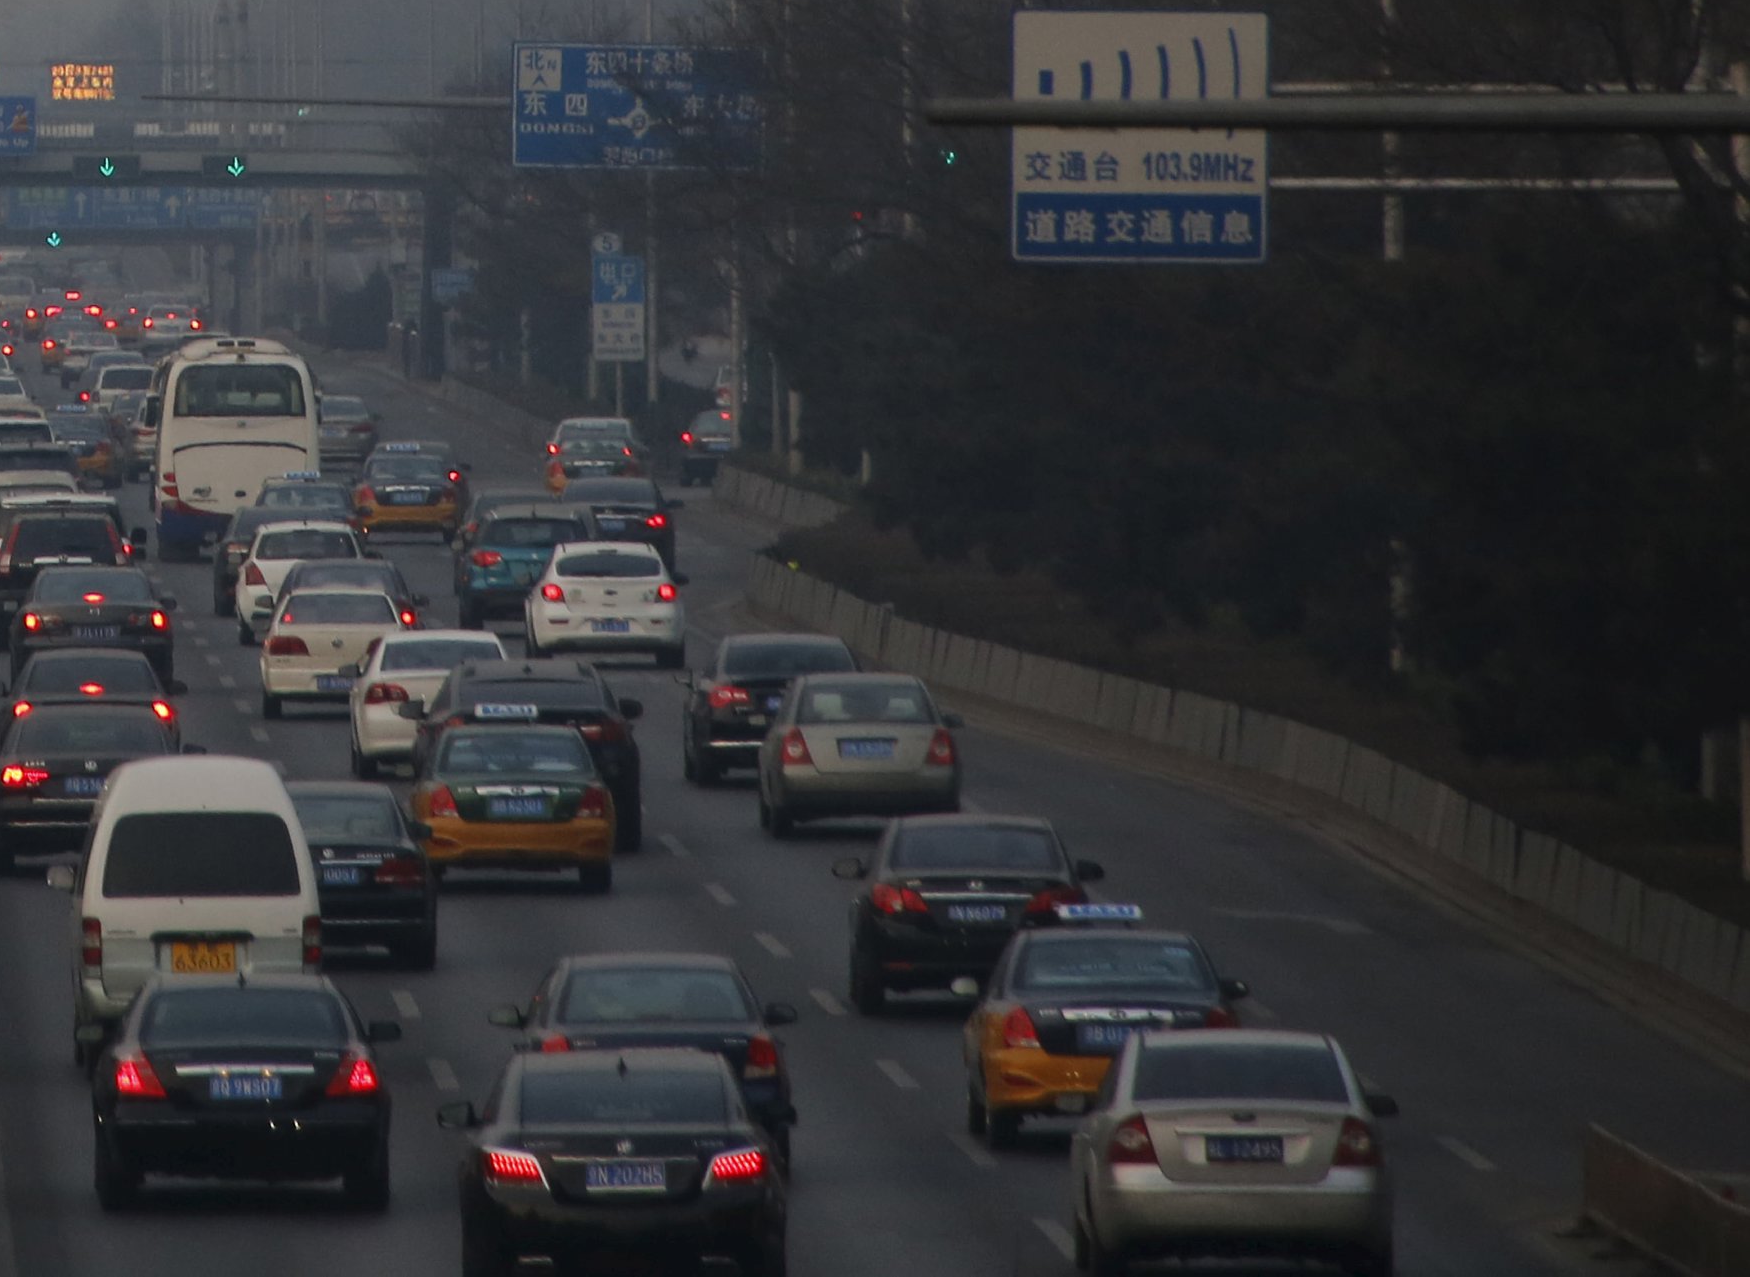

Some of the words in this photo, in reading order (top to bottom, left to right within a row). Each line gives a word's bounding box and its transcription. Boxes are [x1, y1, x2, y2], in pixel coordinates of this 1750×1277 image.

[524, 50, 545, 71] 北
[523, 92, 587, 116] 东四
[1025, 151, 1119, 181] 交通台
[1142, 152, 1256, 183] 103.9MHz
[1025, 209, 1253, 244] 道路交通信息
[175, 952, 231, 971] 63603
